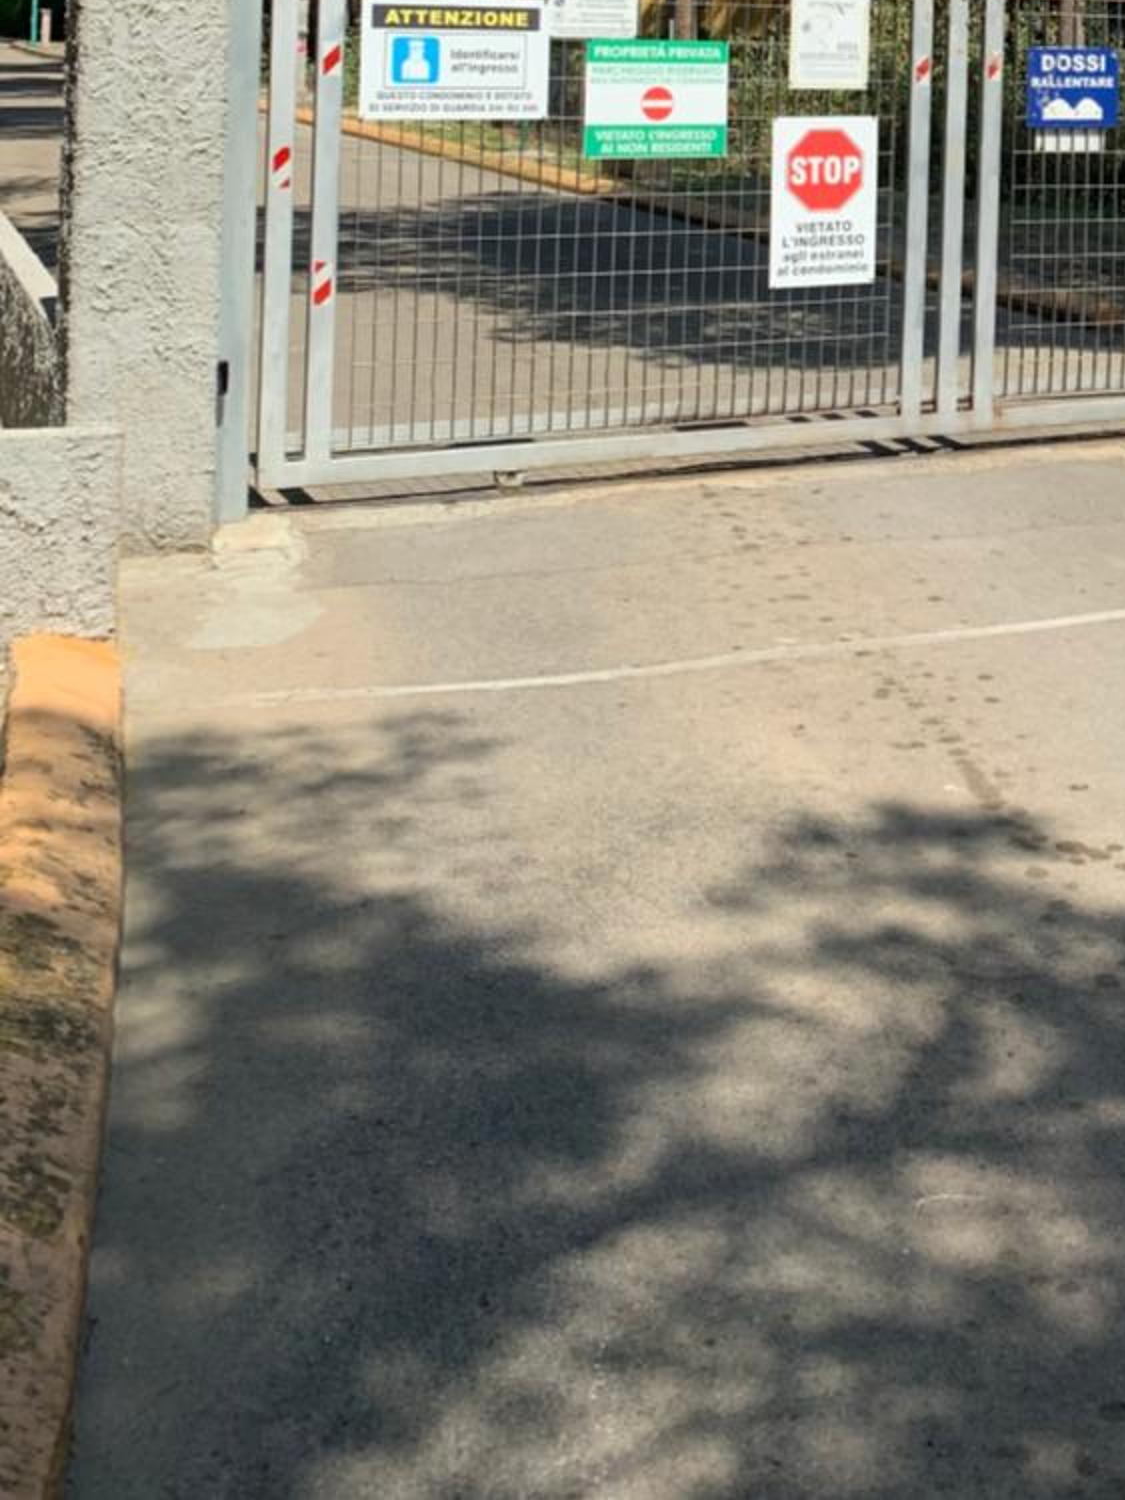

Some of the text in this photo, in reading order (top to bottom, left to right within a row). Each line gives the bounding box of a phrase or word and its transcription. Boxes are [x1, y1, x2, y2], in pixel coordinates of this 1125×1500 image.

[384, 7, 530, 28] ATTENZIONE
[450, 48, 520, 62] Identificarsi
[1041, 53, 1106, 73] DOSSI
[1031, 75, 1115, 90] RALLENTARE
[595, 129, 646, 142] VIETATO
[790, 154, 861, 185] STOP
[795, 220, 853, 233] VIETATO
[782, 233, 865, 248] L'INGRESSO
